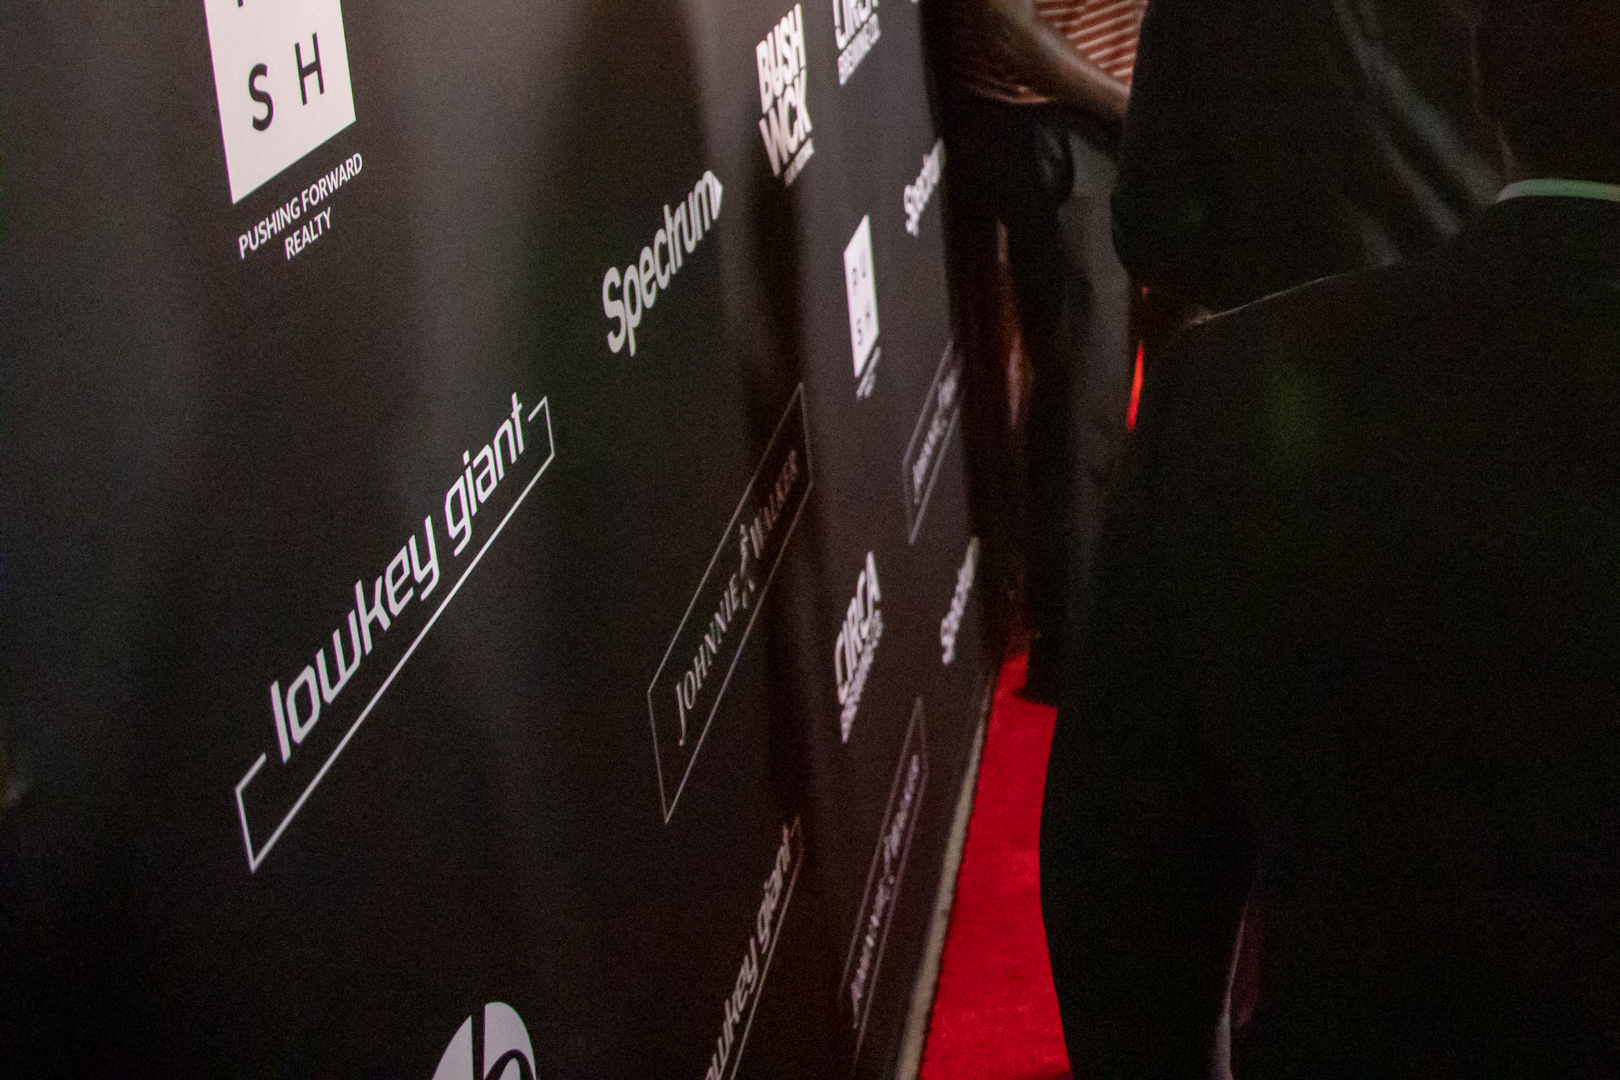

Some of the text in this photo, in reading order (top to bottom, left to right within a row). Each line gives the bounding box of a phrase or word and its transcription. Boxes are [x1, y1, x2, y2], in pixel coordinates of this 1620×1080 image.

[756, 3, 806, 114] BUSH
[759, 67, 812, 177] WCK
[238, 153, 363, 260] PUSHING FORWARD
[284, 206, 331, 260] REALTY
[602, 170, 720, 357] Spectrum
[271, 392, 525, 763] lowkey giant
[676, 573, 740, 747] JOHNNIE
[757, 824, 791, 955] giant
